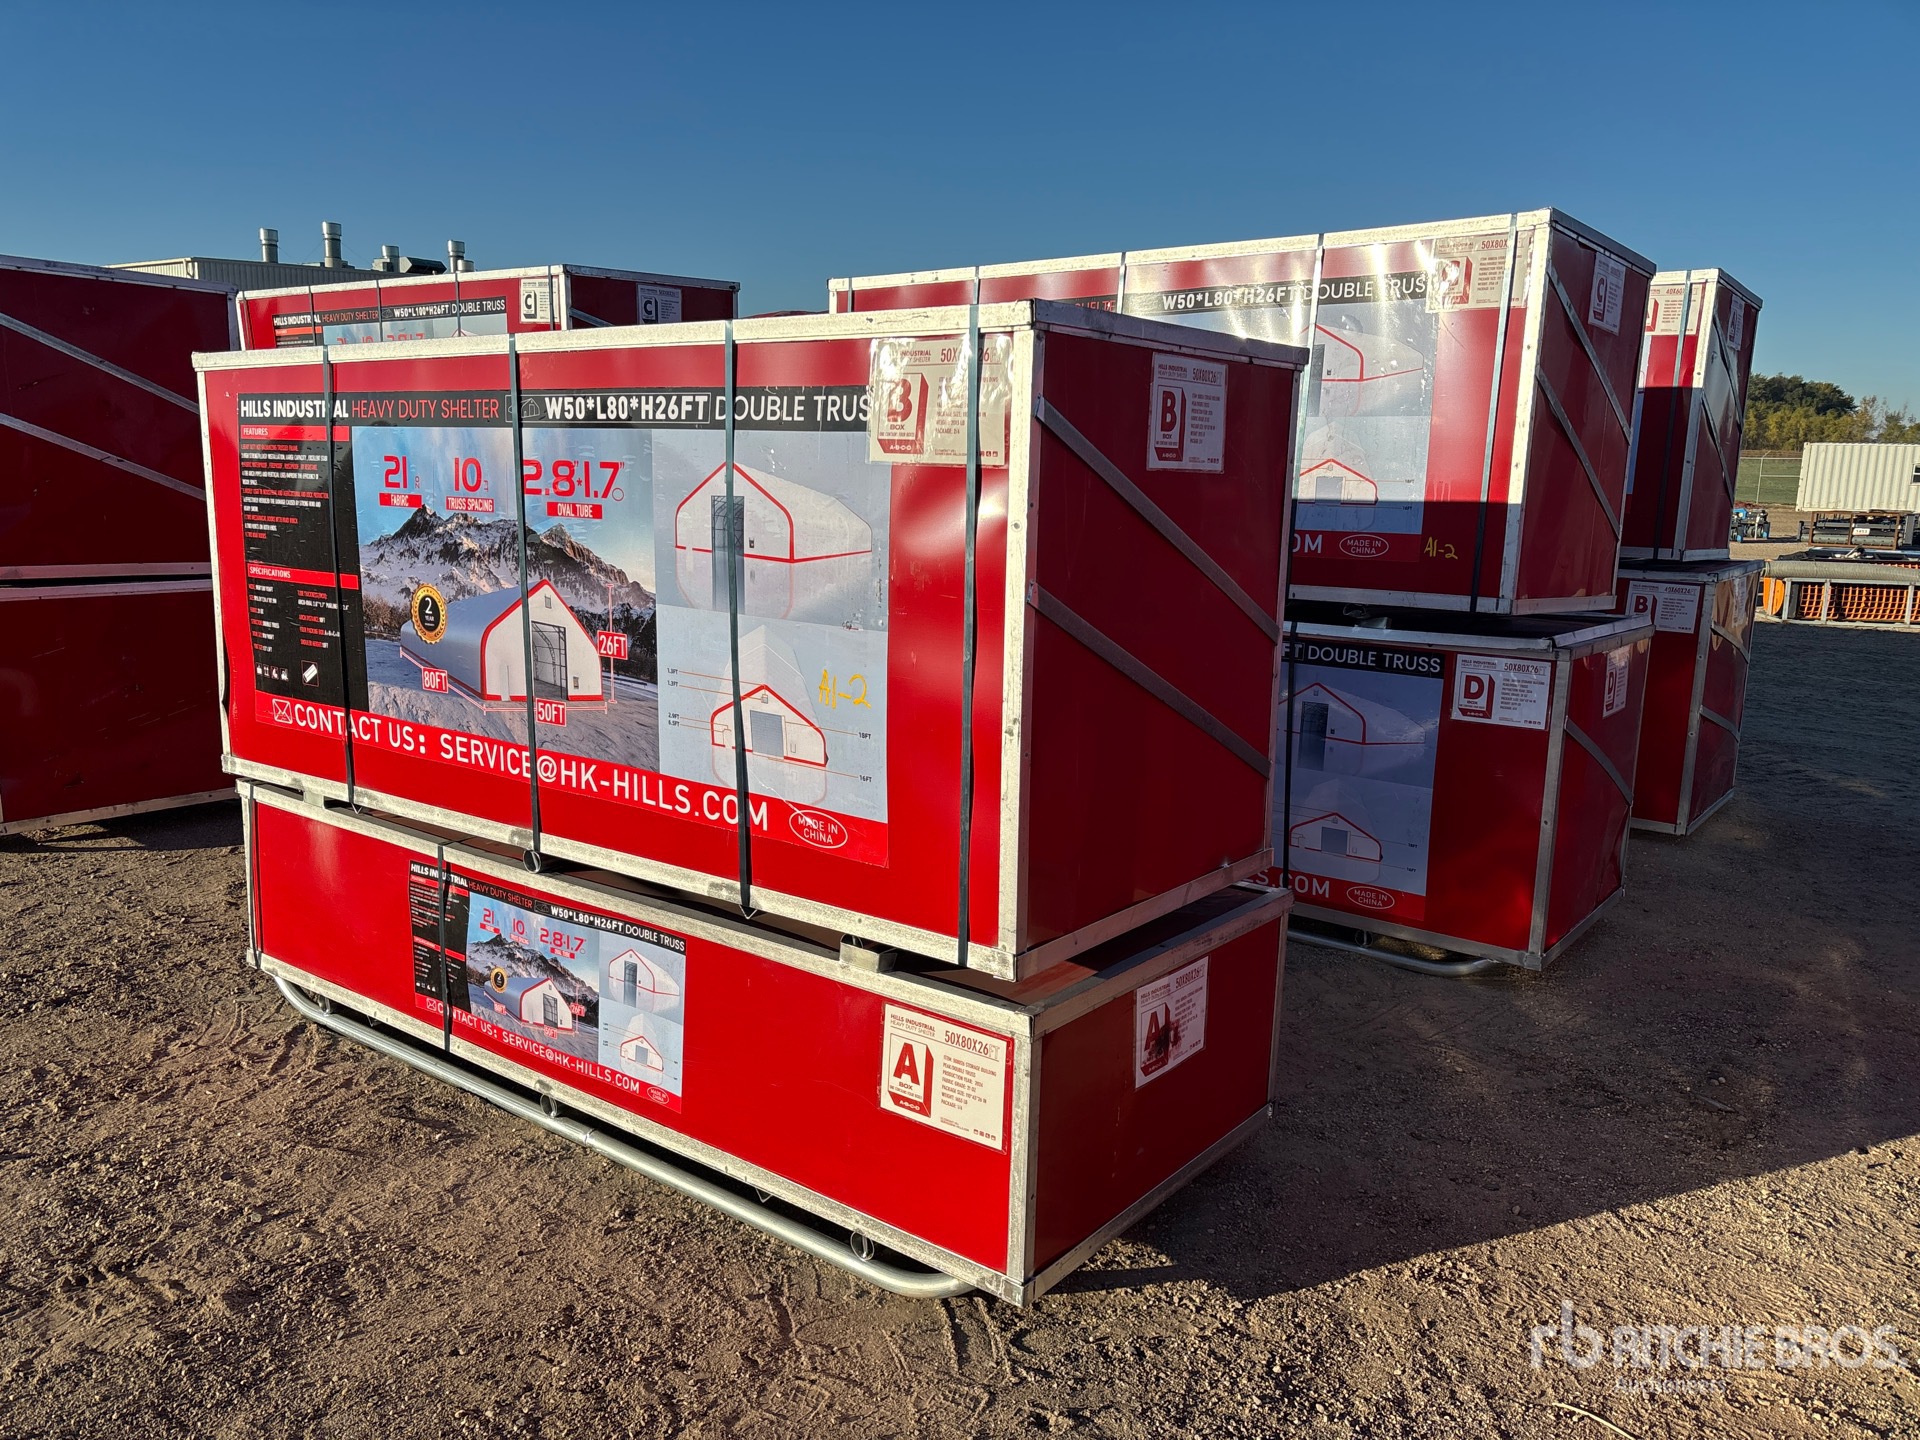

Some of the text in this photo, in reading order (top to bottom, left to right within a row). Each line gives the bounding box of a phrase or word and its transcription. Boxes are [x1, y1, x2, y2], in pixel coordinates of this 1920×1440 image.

[525, 293, 532, 309] C
[643, 299, 653, 315] C
[273, 316, 288, 326] HILLS
[288, 314, 321, 324] INDUSTRAL
[322, 313, 340, 323] HEAVY
[340, 312, 355, 321] DUTY
[482, 299, 506, 311] TRUSS
[240, 399, 271, 418] HILLS
[352, 399, 395, 418] HEAVY
[398, 399, 437, 418] DUTY
[441, 398, 499, 419] SHELTER
[813, 394, 872, 422] TRUS
[1160, 389, 1177, 433] B
[243, 427, 269, 436] FEATURES
[384, 455, 408, 489] 21
[454, 457, 482, 492] 10
[447, 497, 493, 512] TRUSS SPACING
[557, 502, 594, 518] OVAL TUBE
[1346, 538, 1382, 548] MADE IN
[1350, 546, 1376, 555] CHINA
[249, 566, 291, 579] SPECIFICATIONS
[425, 597, 432, 614] 2
[1633, 595, 1648, 613] B
[599, 634, 627, 657] 26FT
[1307, 645, 1377, 666] DOUBLE
[1382, 652, 1441, 673] TRUSS
[423, 671, 447, 691] 80FT
[1463, 674, 1485, 700] D
[537, 702, 565, 724] 50FT
[294, 704, 381, 742] CONTACT
[803, 827, 833, 844] CHINA
[827, 822, 838, 834] IN
[1354, 888, 1388, 901] MADE IN
[1357, 896, 1383, 907] CHINA
[410, 863, 429, 876] HILLS
[468, 881, 490, 894] HEAVY
[490, 887, 507, 900] DUTY
[507, 892, 533, 909] SHELTER
[625, 924, 658, 943] DOUBLE
[660, 934, 686, 952] TRUSS
[890, 1013, 935, 1032] HILLS INDUSTRIAL
[502, 1031, 640, 1095] SERVICE@HK-HILLS.COM
[893, 1042, 920, 1086] A
[898, 1081, 913, 1091] BOX
